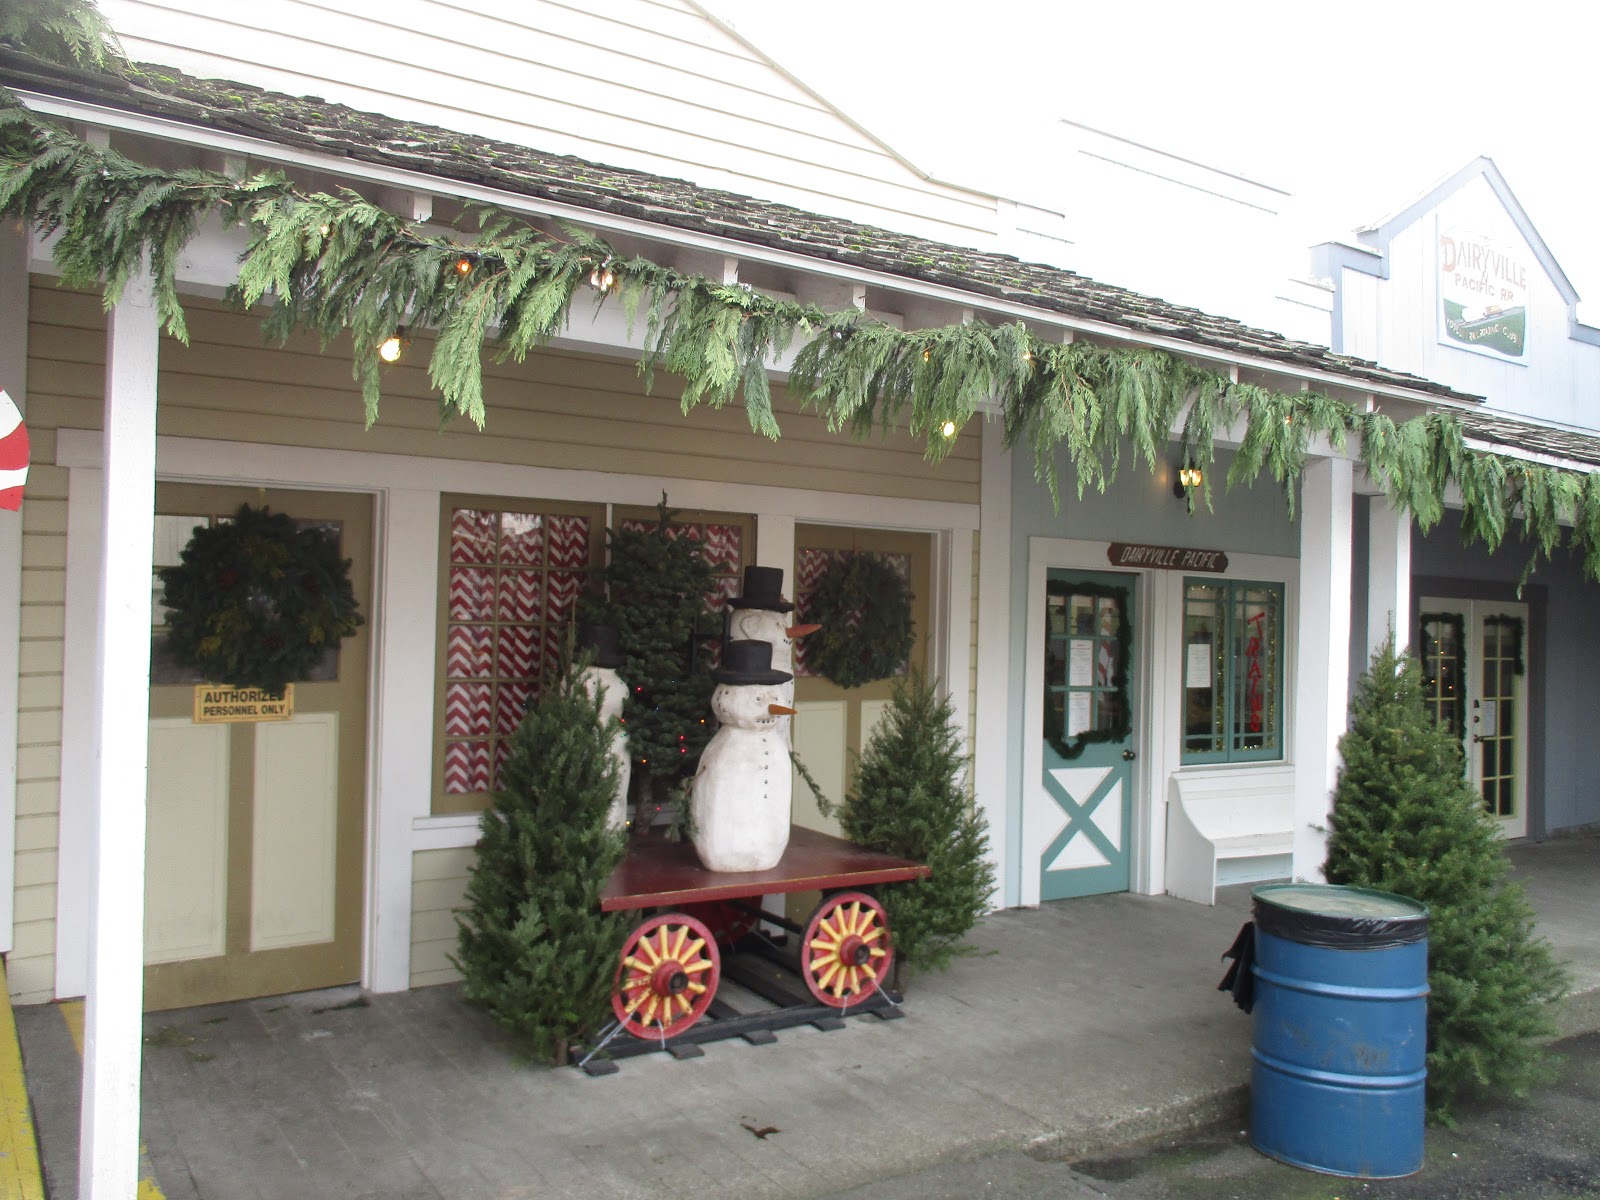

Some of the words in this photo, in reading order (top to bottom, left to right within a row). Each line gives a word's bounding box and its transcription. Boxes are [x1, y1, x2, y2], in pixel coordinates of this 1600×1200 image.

[1440, 235, 1527, 291] DAIRYVILLE
[1454, 272, 1495, 297] PACIFIC
[1500, 287, 1514, 302] RR
[1120, 546, 1180, 566] DAIRYVILLE
[1181, 550, 1219, 569] PACIFIC
[203, 705, 258, 716] PERSONNEL
[261, 704, 285, 715] ONLY
